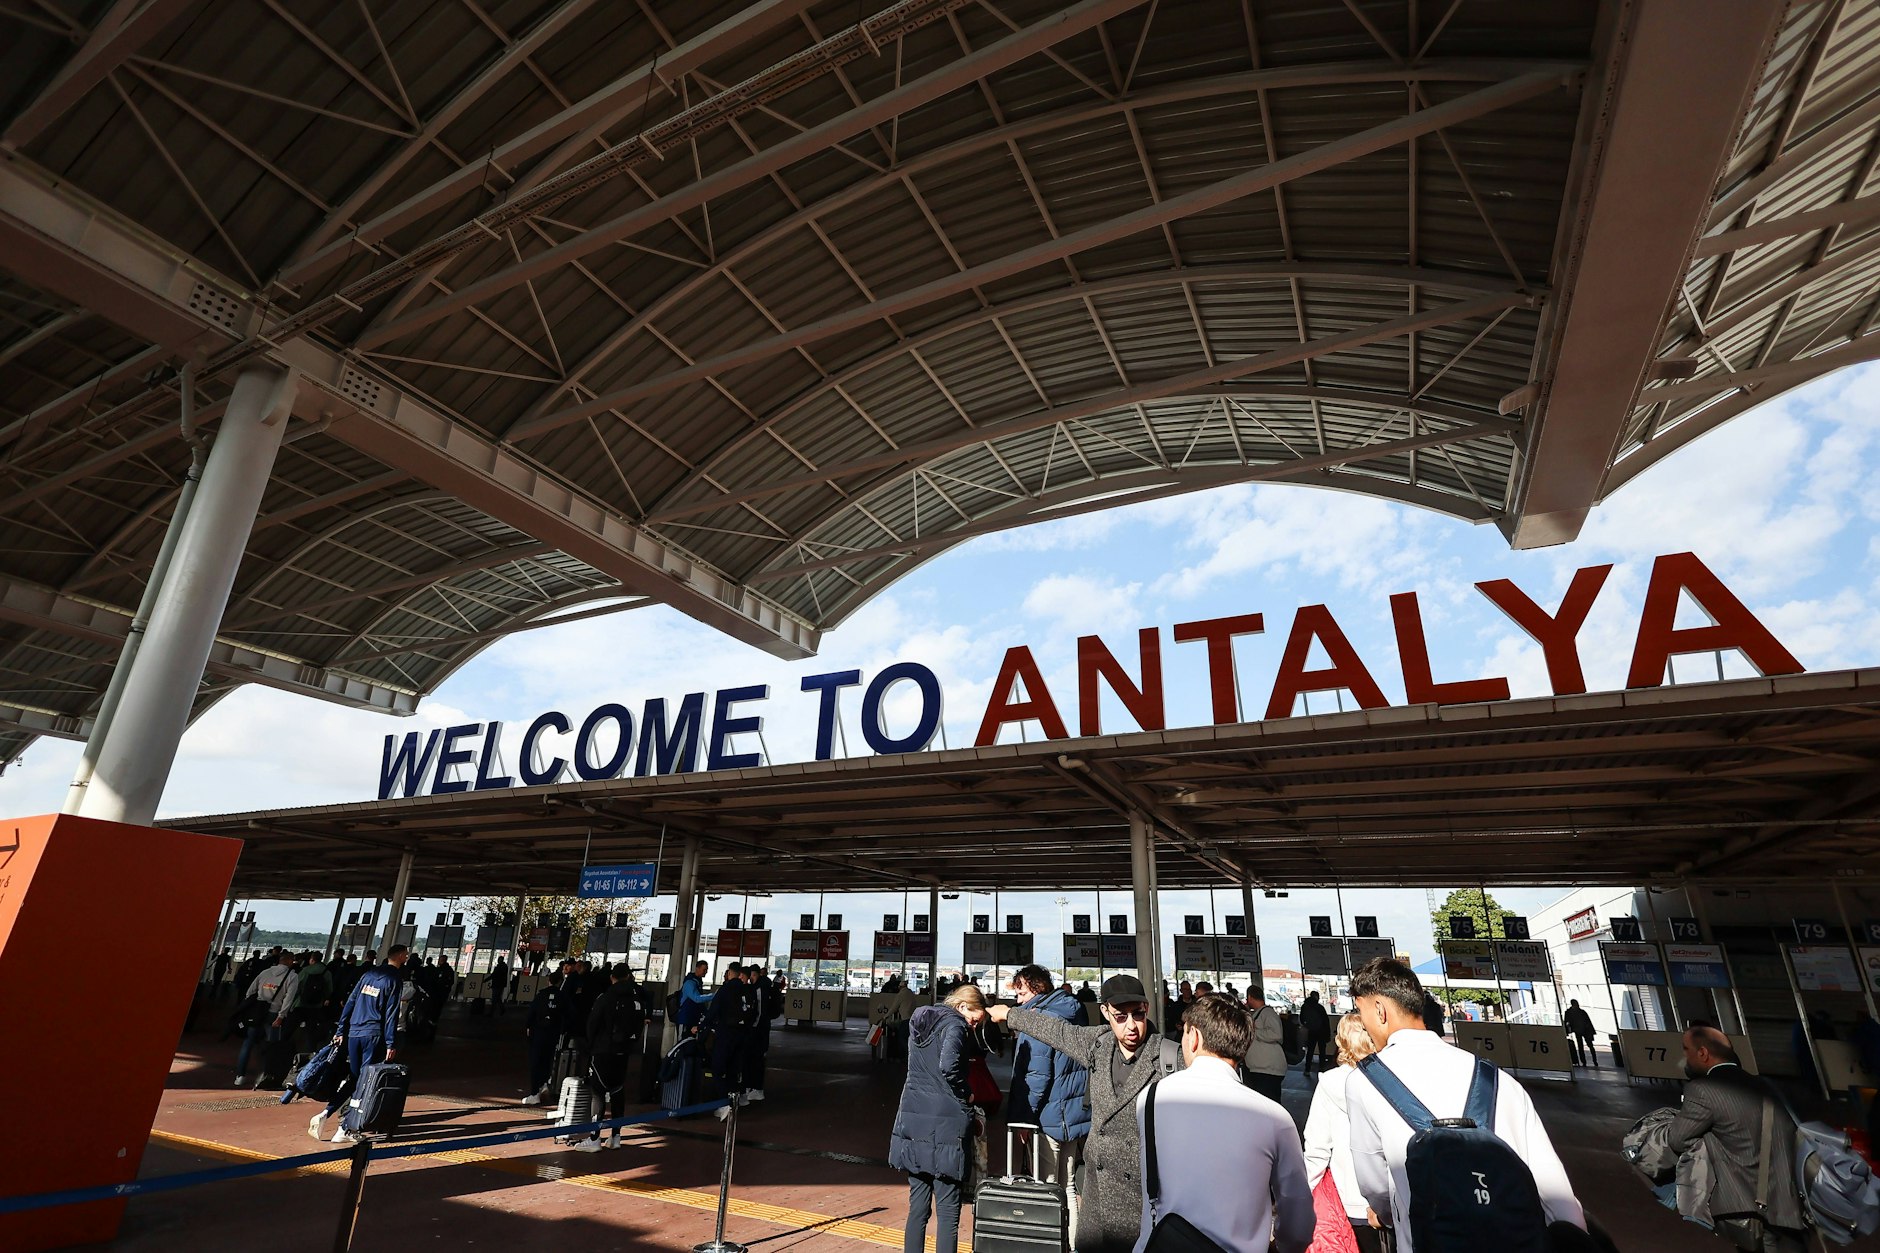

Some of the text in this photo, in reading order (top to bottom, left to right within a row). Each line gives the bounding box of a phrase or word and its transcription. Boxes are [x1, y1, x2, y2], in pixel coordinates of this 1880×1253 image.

[378, 551, 1806, 800] WELCOME TO ANTALYA
[594, 880, 610, 891] 01-65
[617, 878, 638, 890] 66-112
[1007, 918, 1021, 929] 68
[1074, 918, 1089, 929] 69
[1110, 918, 1125, 930] 70
[1186, 919, 1201, 931] 71
[1227, 919, 1244, 931] 72
[1311, 920, 1329, 932] 73
[1356, 920, 1376, 932] 74
[1452, 921, 1472, 934] 75
[1505, 921, 1527, 934] 76
[1613, 922, 1636, 936] 77
[1674, 922, 1699, 937] 78
[1800, 923, 1826, 939] 79
[1870, 924, 1880, 940] 8
[1500, 944, 1540, 954] Kalanit
[793, 999, 803, 1009] 63
[820, 1001, 831, 1011] 64
[1529, 1040, 1549, 1054] 76
[1645, 1047, 1667, 1062] 77
[1474, 1188, 1491, 1205] 19
